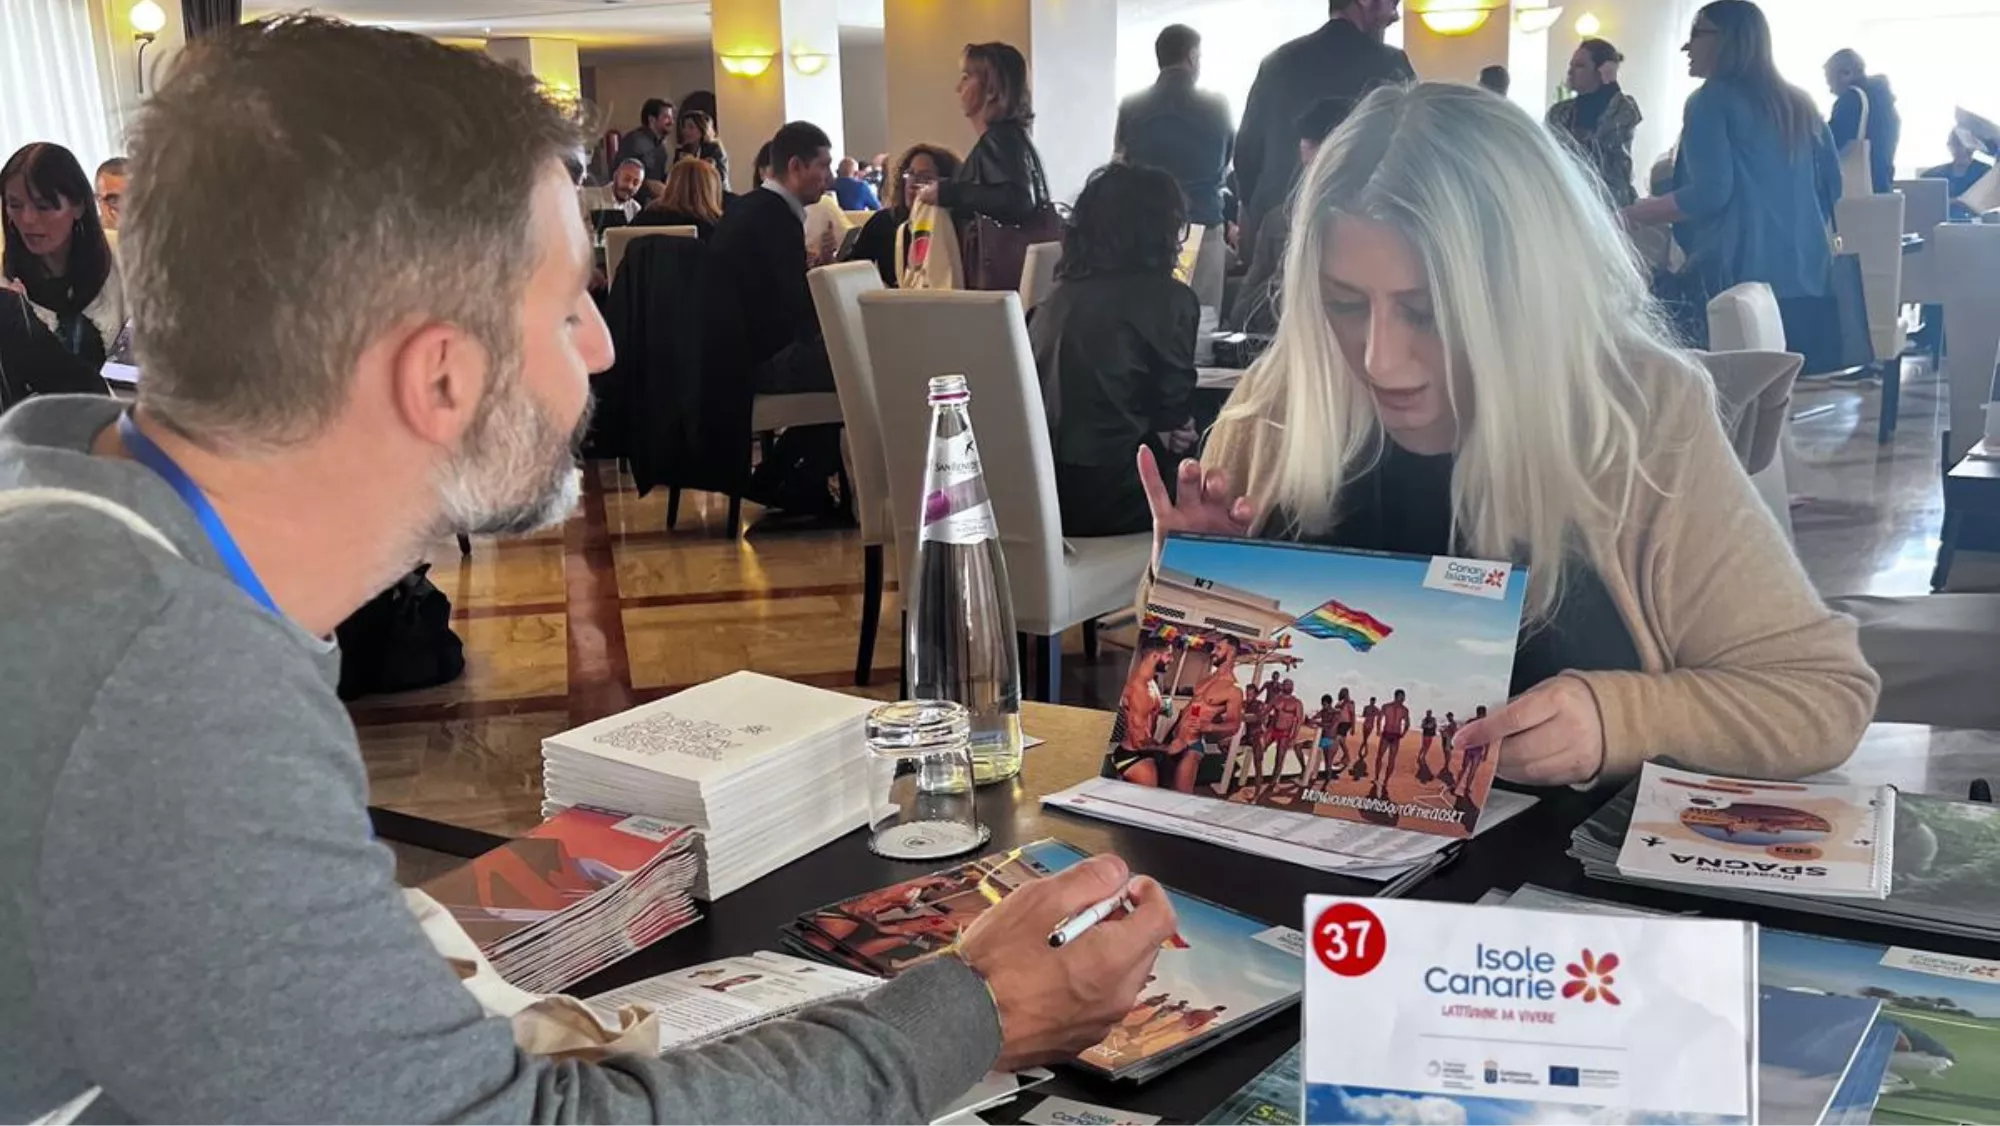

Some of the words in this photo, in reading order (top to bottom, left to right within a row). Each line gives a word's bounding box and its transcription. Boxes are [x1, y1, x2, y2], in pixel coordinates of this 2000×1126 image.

[1671, 853, 1828, 877] SPAGNA
[1696, 865, 1796, 881] Roadshow
[1322, 920, 1371, 961] 37
[1477, 942, 1556, 973] Isole
[1424, 966, 1556, 1001] Canarie
